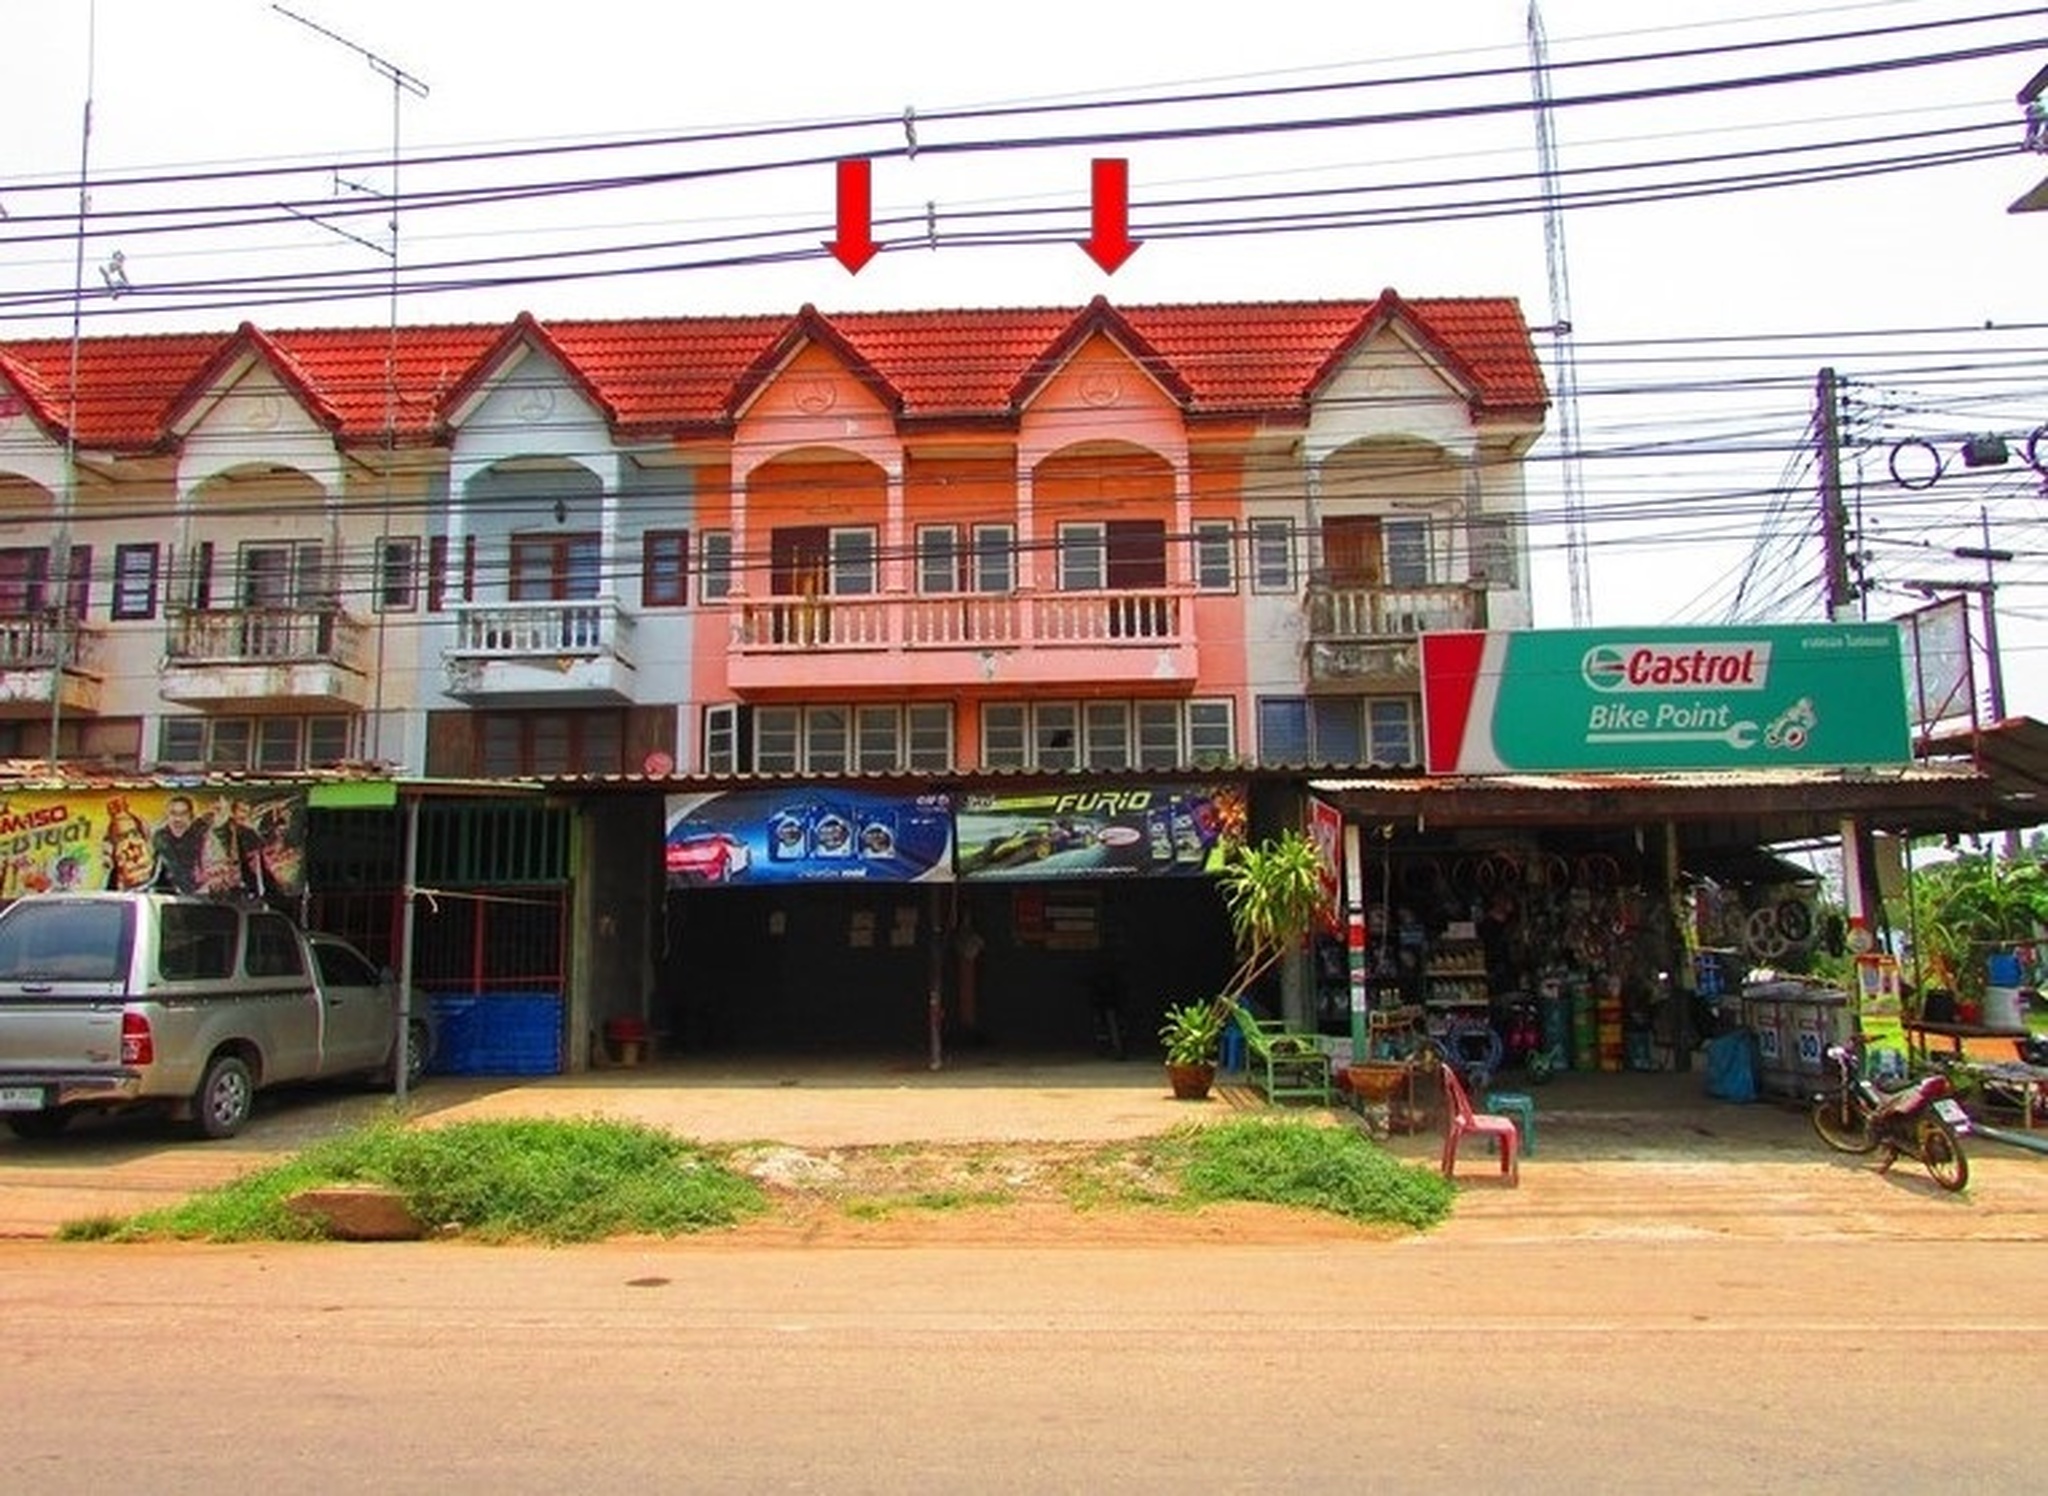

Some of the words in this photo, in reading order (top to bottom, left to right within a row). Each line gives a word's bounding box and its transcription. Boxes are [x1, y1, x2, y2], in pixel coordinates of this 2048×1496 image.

[1628, 649, 1755, 685] Castrol
[1588, 704, 1649, 729] Bike
[1655, 702, 1732, 728] Point
